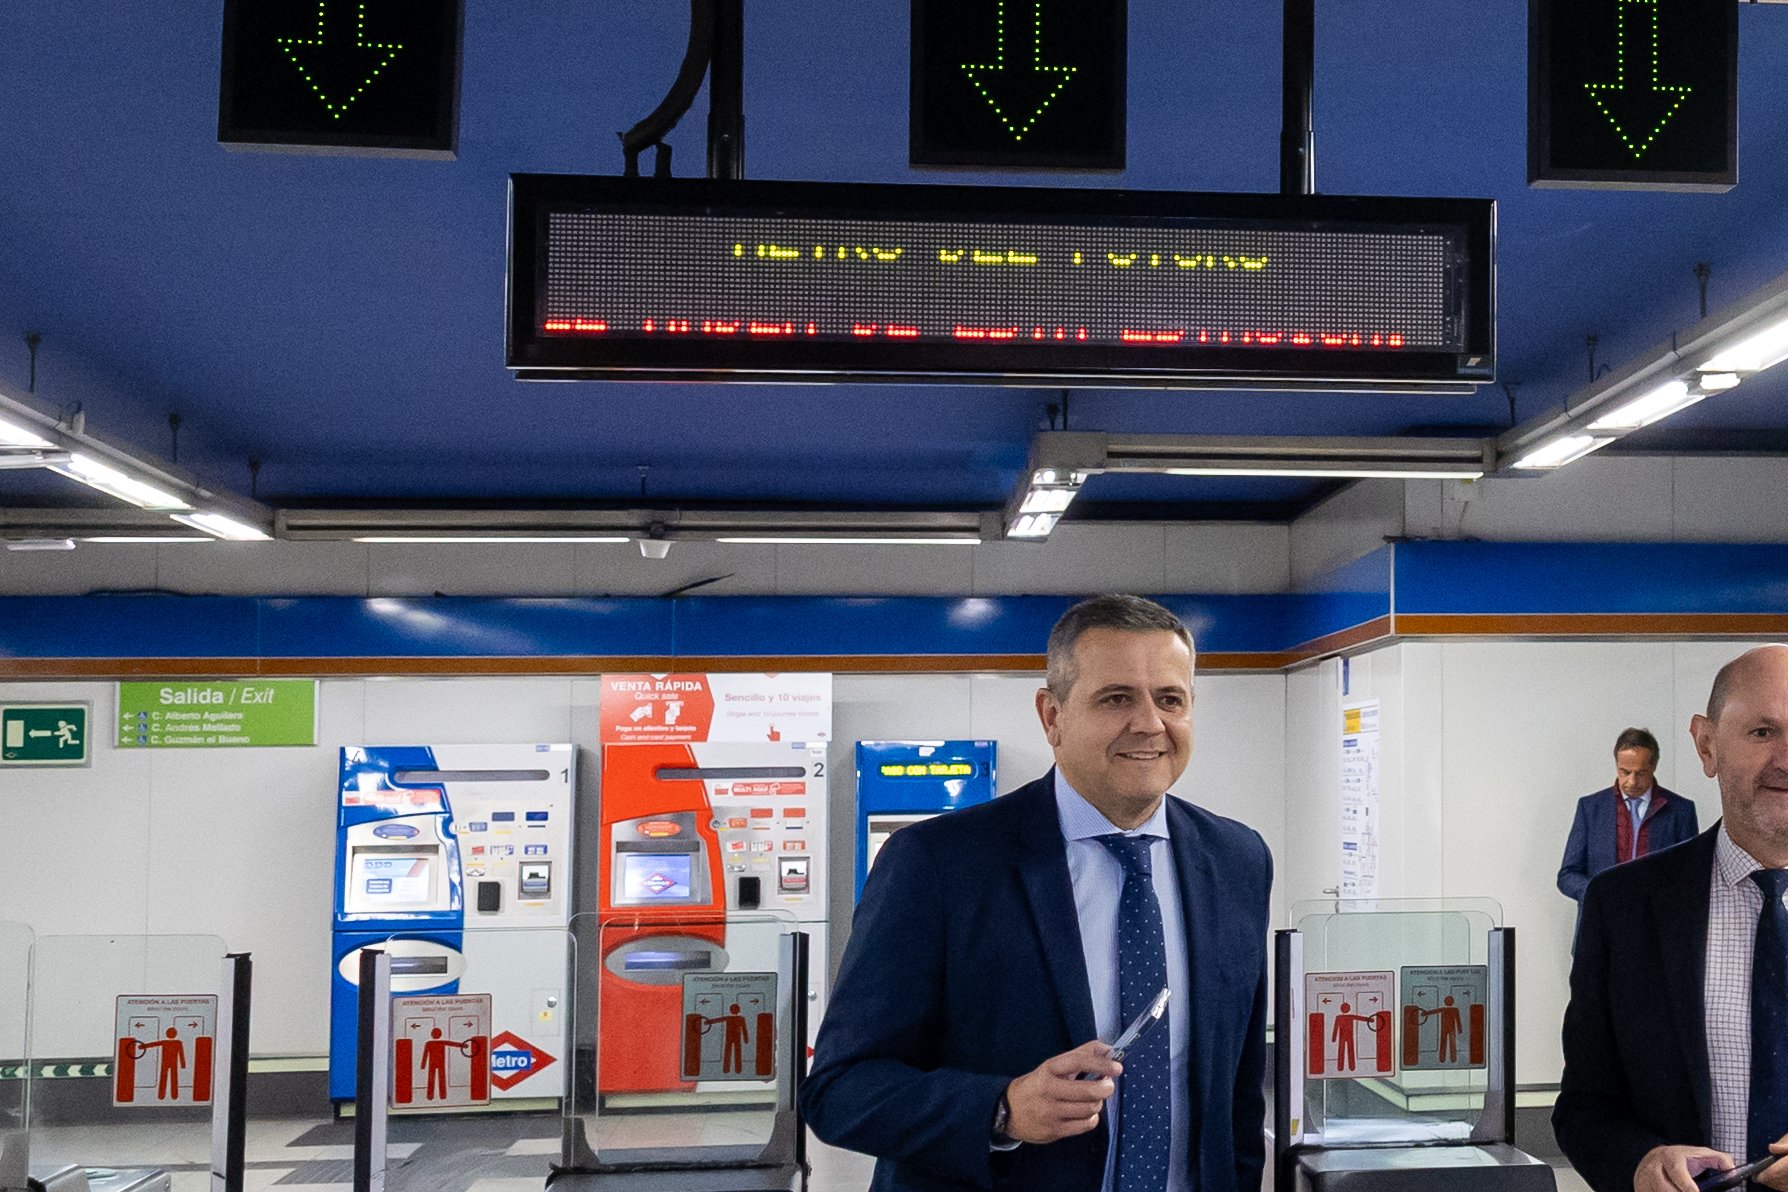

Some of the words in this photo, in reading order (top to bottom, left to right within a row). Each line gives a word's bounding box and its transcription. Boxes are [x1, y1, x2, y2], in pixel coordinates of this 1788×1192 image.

[610, 681, 651, 692] VENTA
[655, 680, 703, 692] RÁPIDA
[160, 688, 224, 705] Salida
[240, 688, 275, 705] Exit
[724, 693, 765, 702] Sencillo
[767, 694, 775, 704] y
[778, 693, 789, 702] 10
[791, 693, 822, 704] viajes
[218, 735, 250, 744] Bueno
[560, 768, 569, 784] 1
[813, 763, 824, 778] 2
